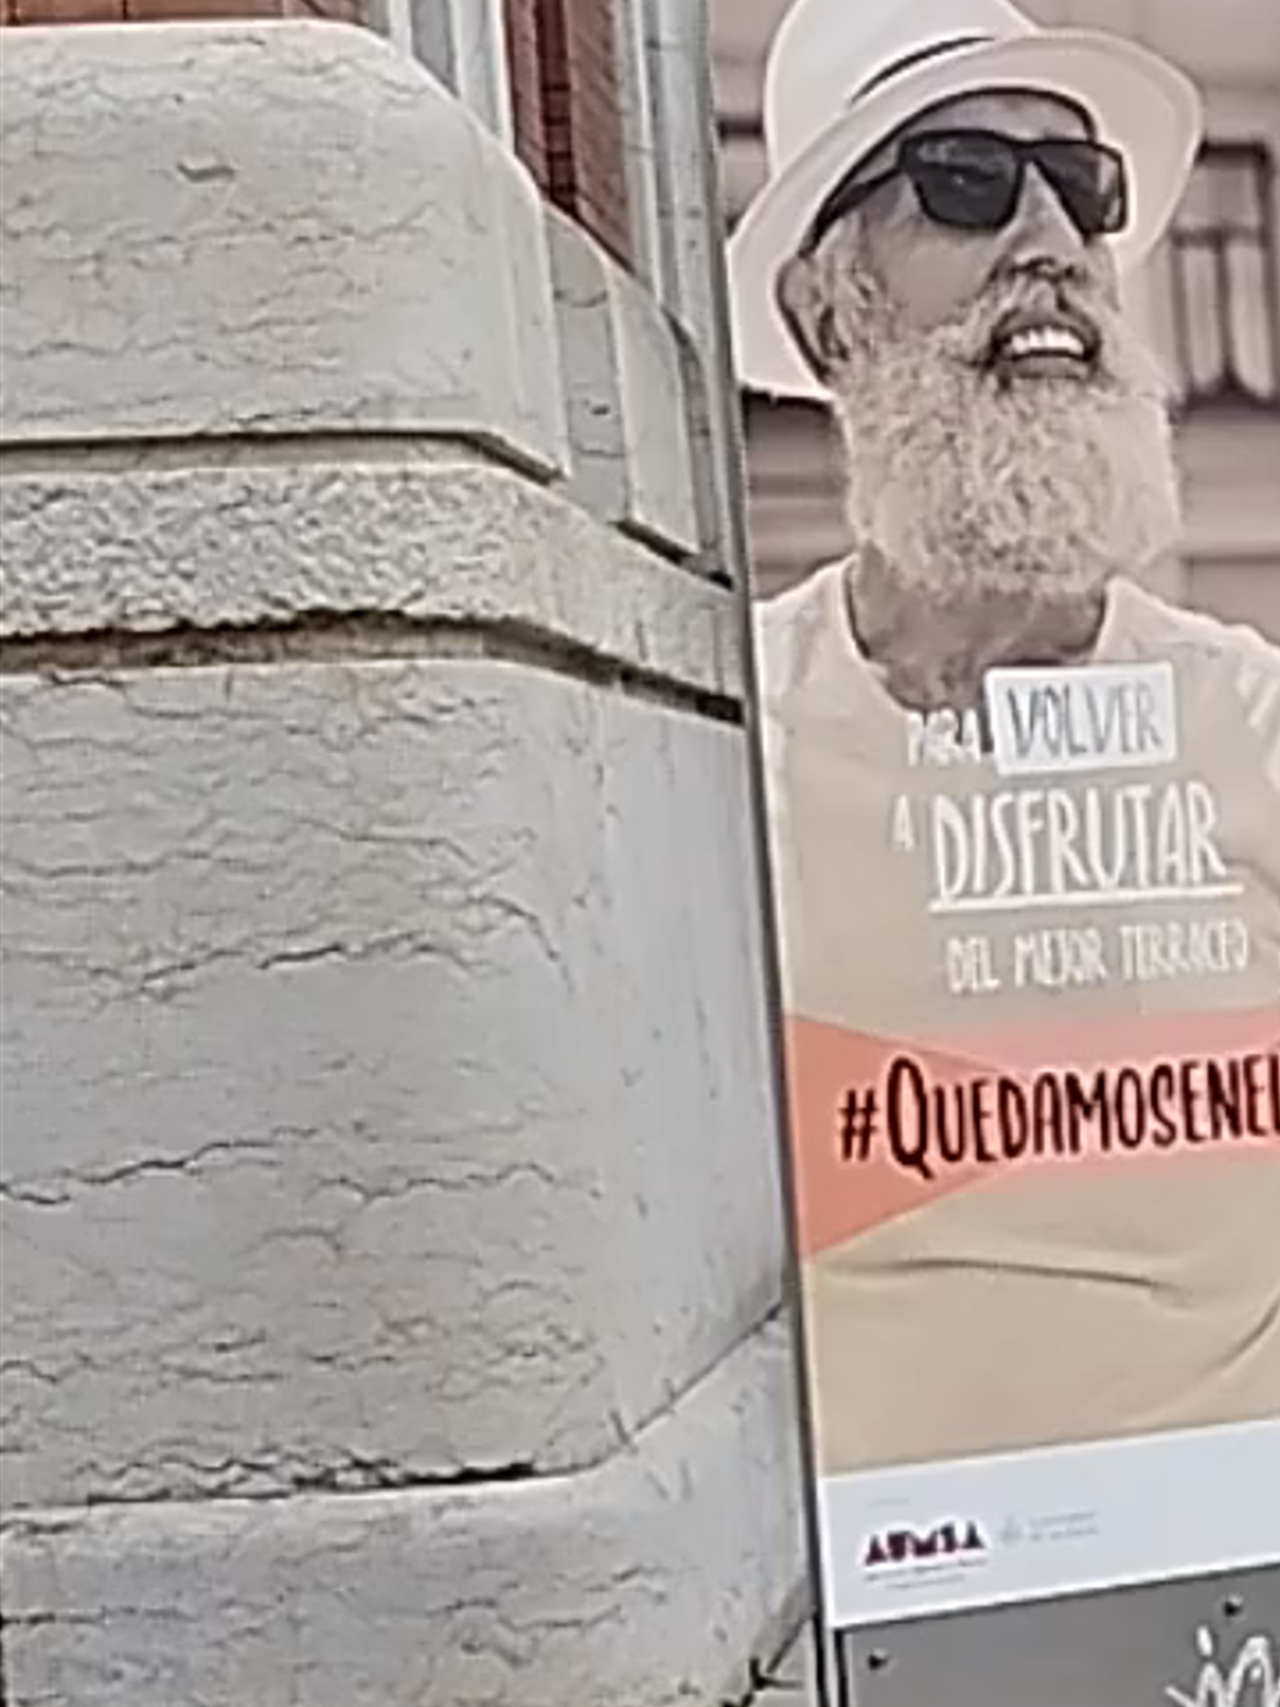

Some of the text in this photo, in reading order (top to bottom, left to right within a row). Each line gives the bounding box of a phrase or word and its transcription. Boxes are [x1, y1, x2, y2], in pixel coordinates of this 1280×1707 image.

[907, 679, 1163, 767] PARA VOLVER
[893, 781, 1226, 903] A DISFRUTAR
[946, 936, 999, 992] DEL
[1014, 927, 1106, 988] MEJOR
